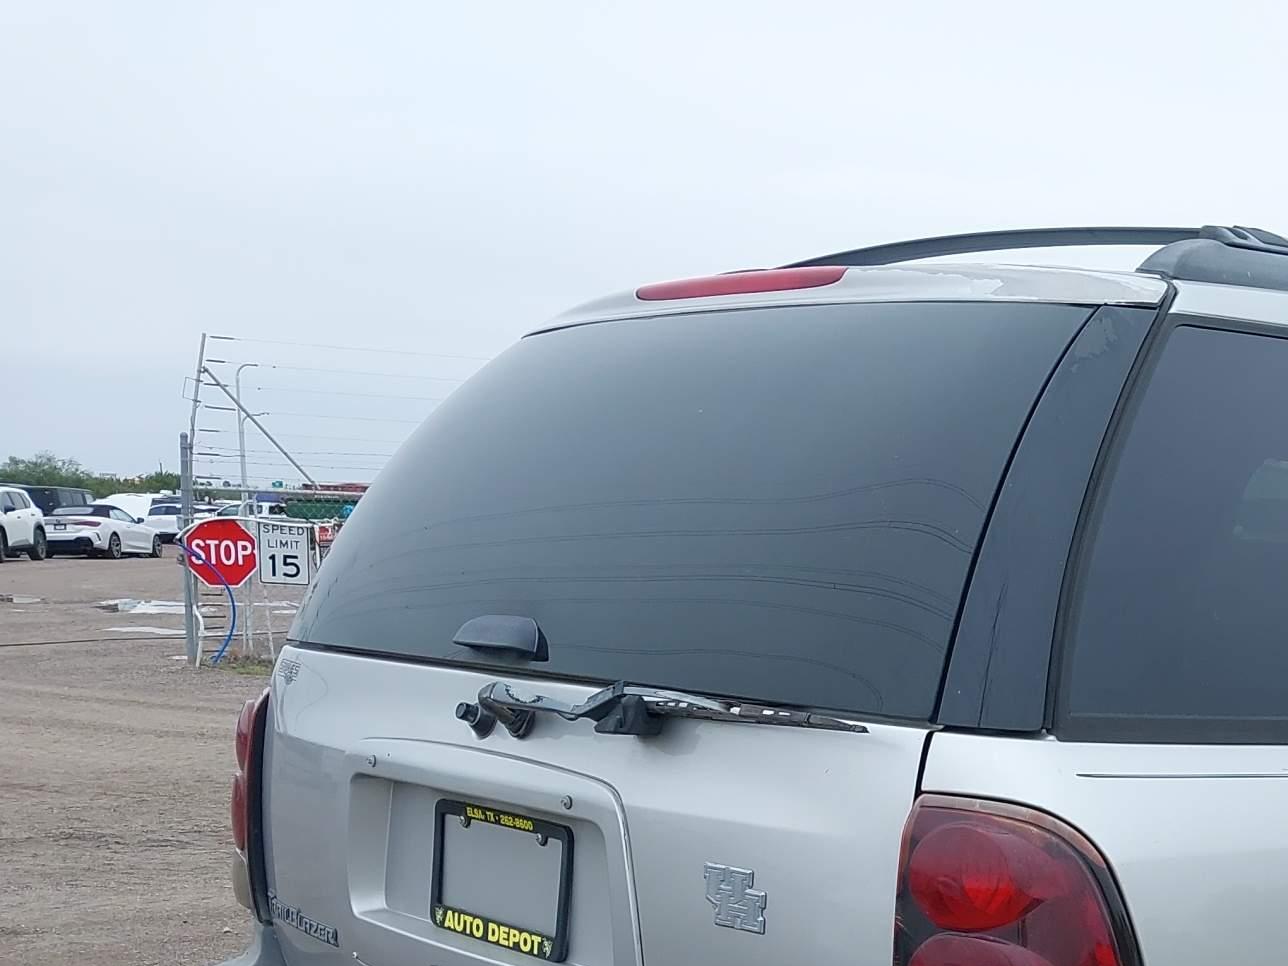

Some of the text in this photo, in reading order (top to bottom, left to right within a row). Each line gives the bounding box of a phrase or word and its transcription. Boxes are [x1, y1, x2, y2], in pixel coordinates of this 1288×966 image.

[262, 524, 304, 536] SPEED
[191, 538, 252, 566] STOP
[267, 538, 300, 550] LIMIT
[268, 553, 301, 578] 15
[444, 910, 541, 955] AUTO DEPOT
